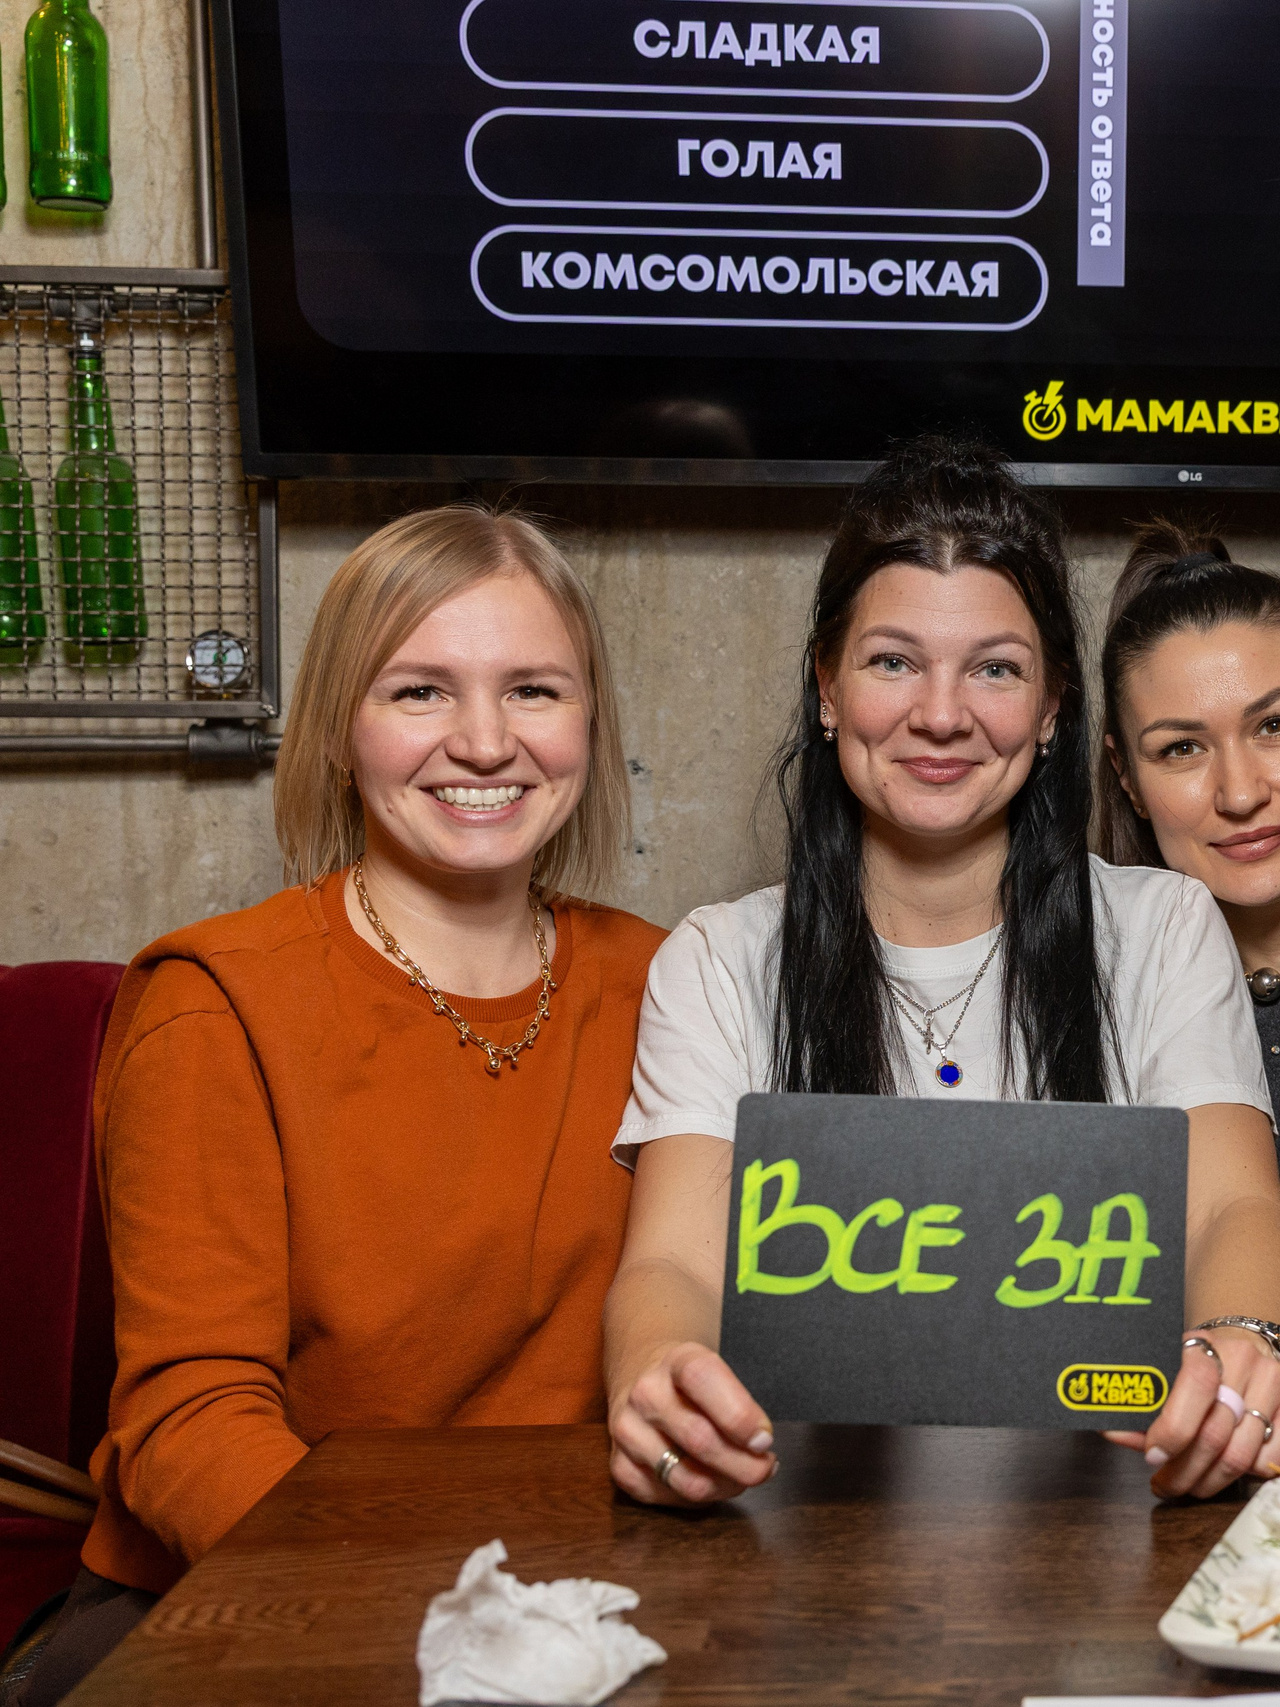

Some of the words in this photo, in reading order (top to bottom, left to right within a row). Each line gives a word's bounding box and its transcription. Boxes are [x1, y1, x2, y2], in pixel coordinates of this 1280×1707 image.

[633, 20, 880, 67] СЛАДКАЯ
[677, 138, 842, 180] ГОЛАЯ
[1090, 115, 1113, 246] ответа
[520, 251, 1000, 297] КОМСОМОЛЬСКАЯ
[1190, 472, 1203, 482] LG
[736, 1158, 966, 1295] ВСЕ
[995, 1193, 1161, 1308] ЗА
[1091, 1372, 1154, 1389] МАМА
[1091, 1387, 1155, 1405] КВИЗ!
